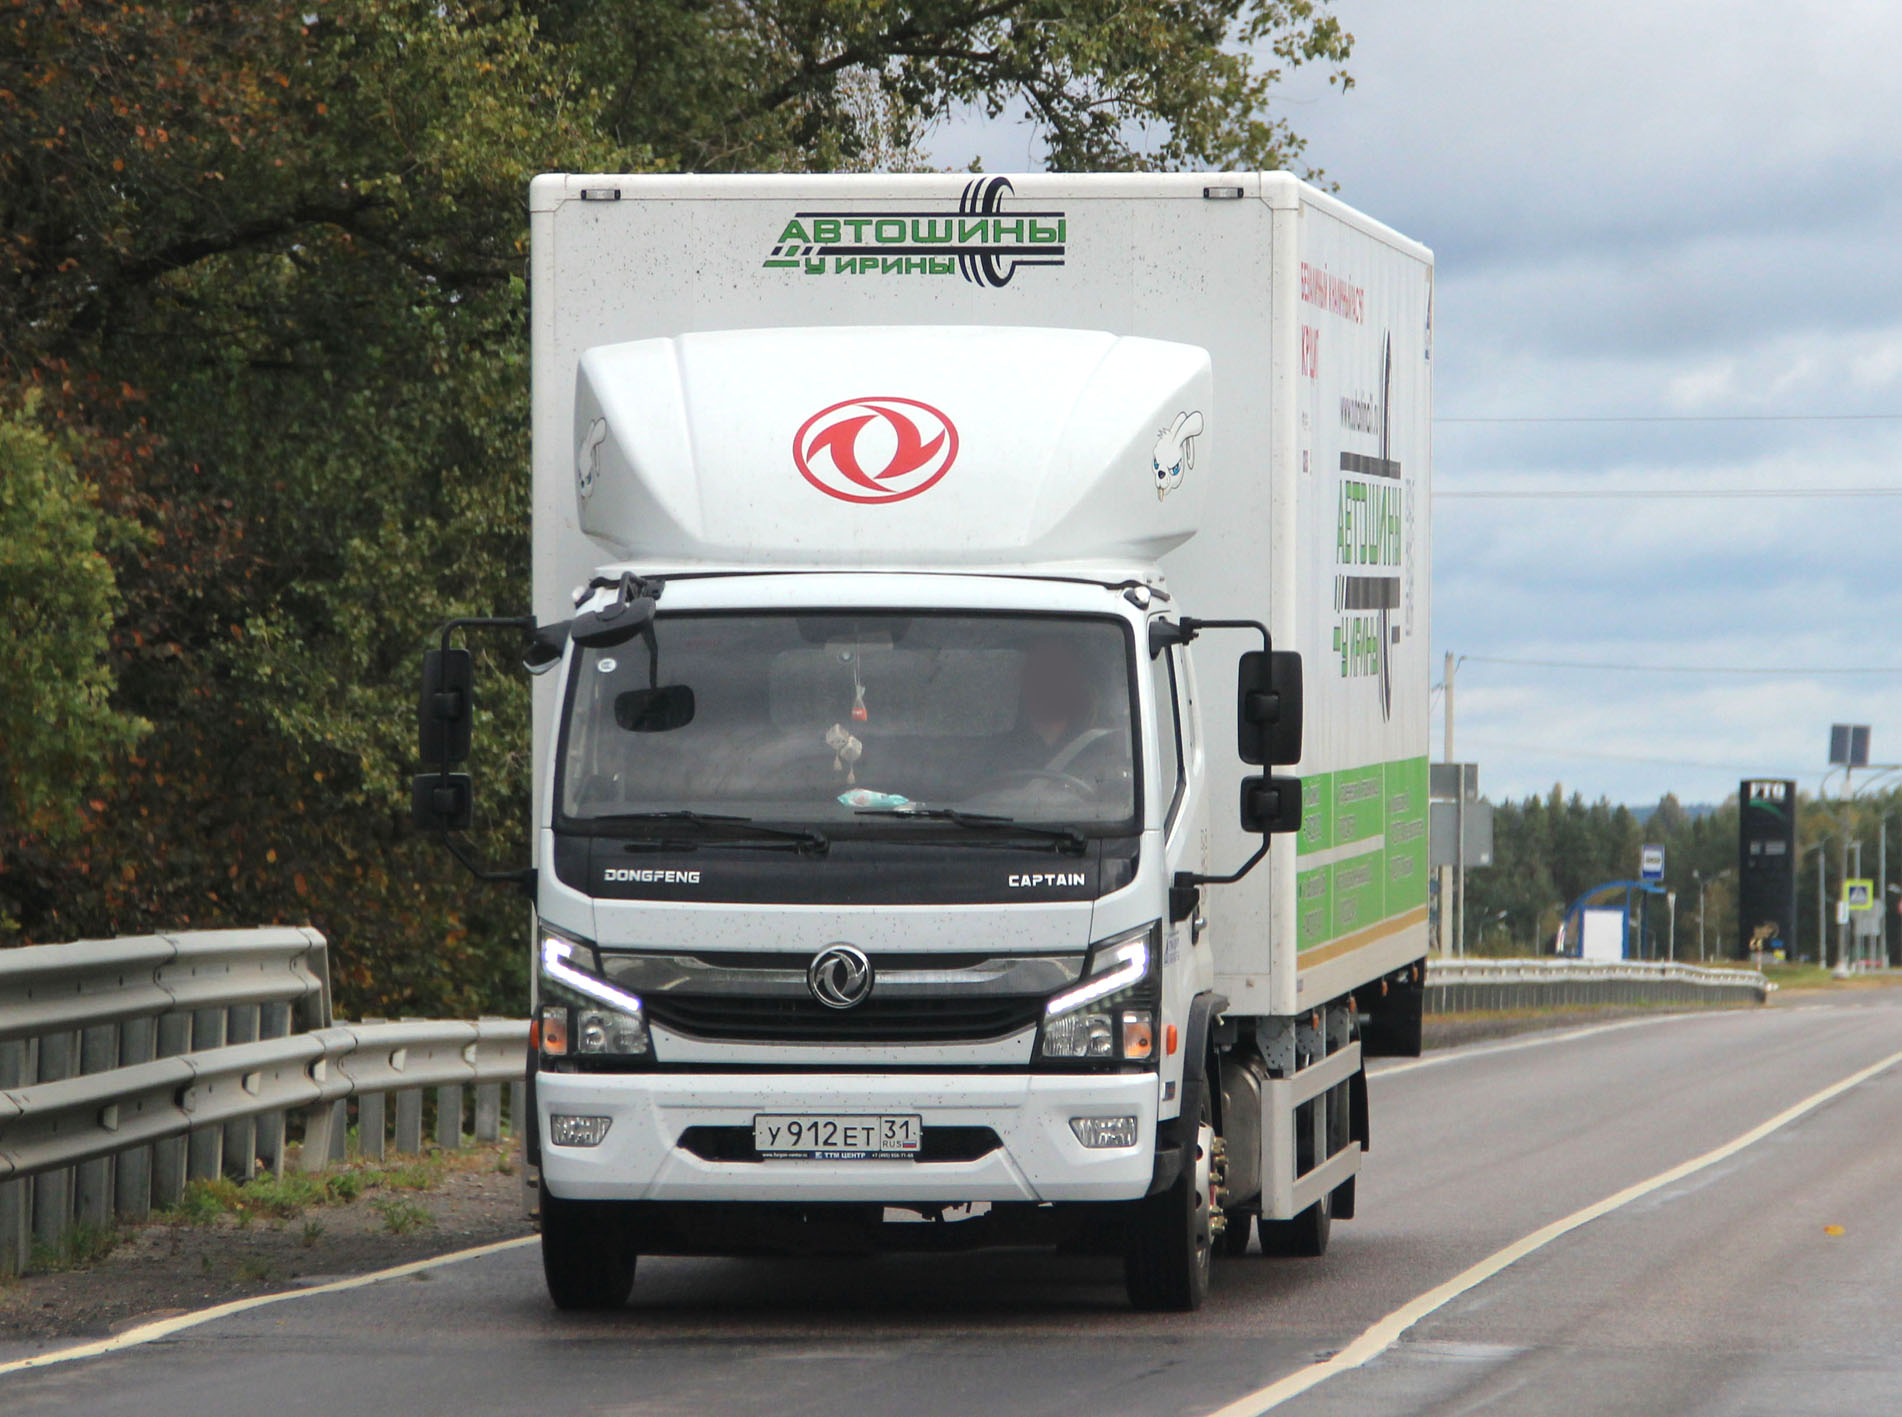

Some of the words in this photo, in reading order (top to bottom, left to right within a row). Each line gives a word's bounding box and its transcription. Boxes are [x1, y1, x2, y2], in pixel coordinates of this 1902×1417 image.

[778, 219, 1067, 244] АВТОШИНЫ
[804, 256, 826, 275] У
[835, 256, 955, 275] ИРИНЫ
[603, 868, 701, 884] DONGFENG
[1008, 872, 1087, 888] CAPTAIN
[882, 1140, 903, 1149] RUS
[841, 1151, 867, 1160] ЦЕНТР
